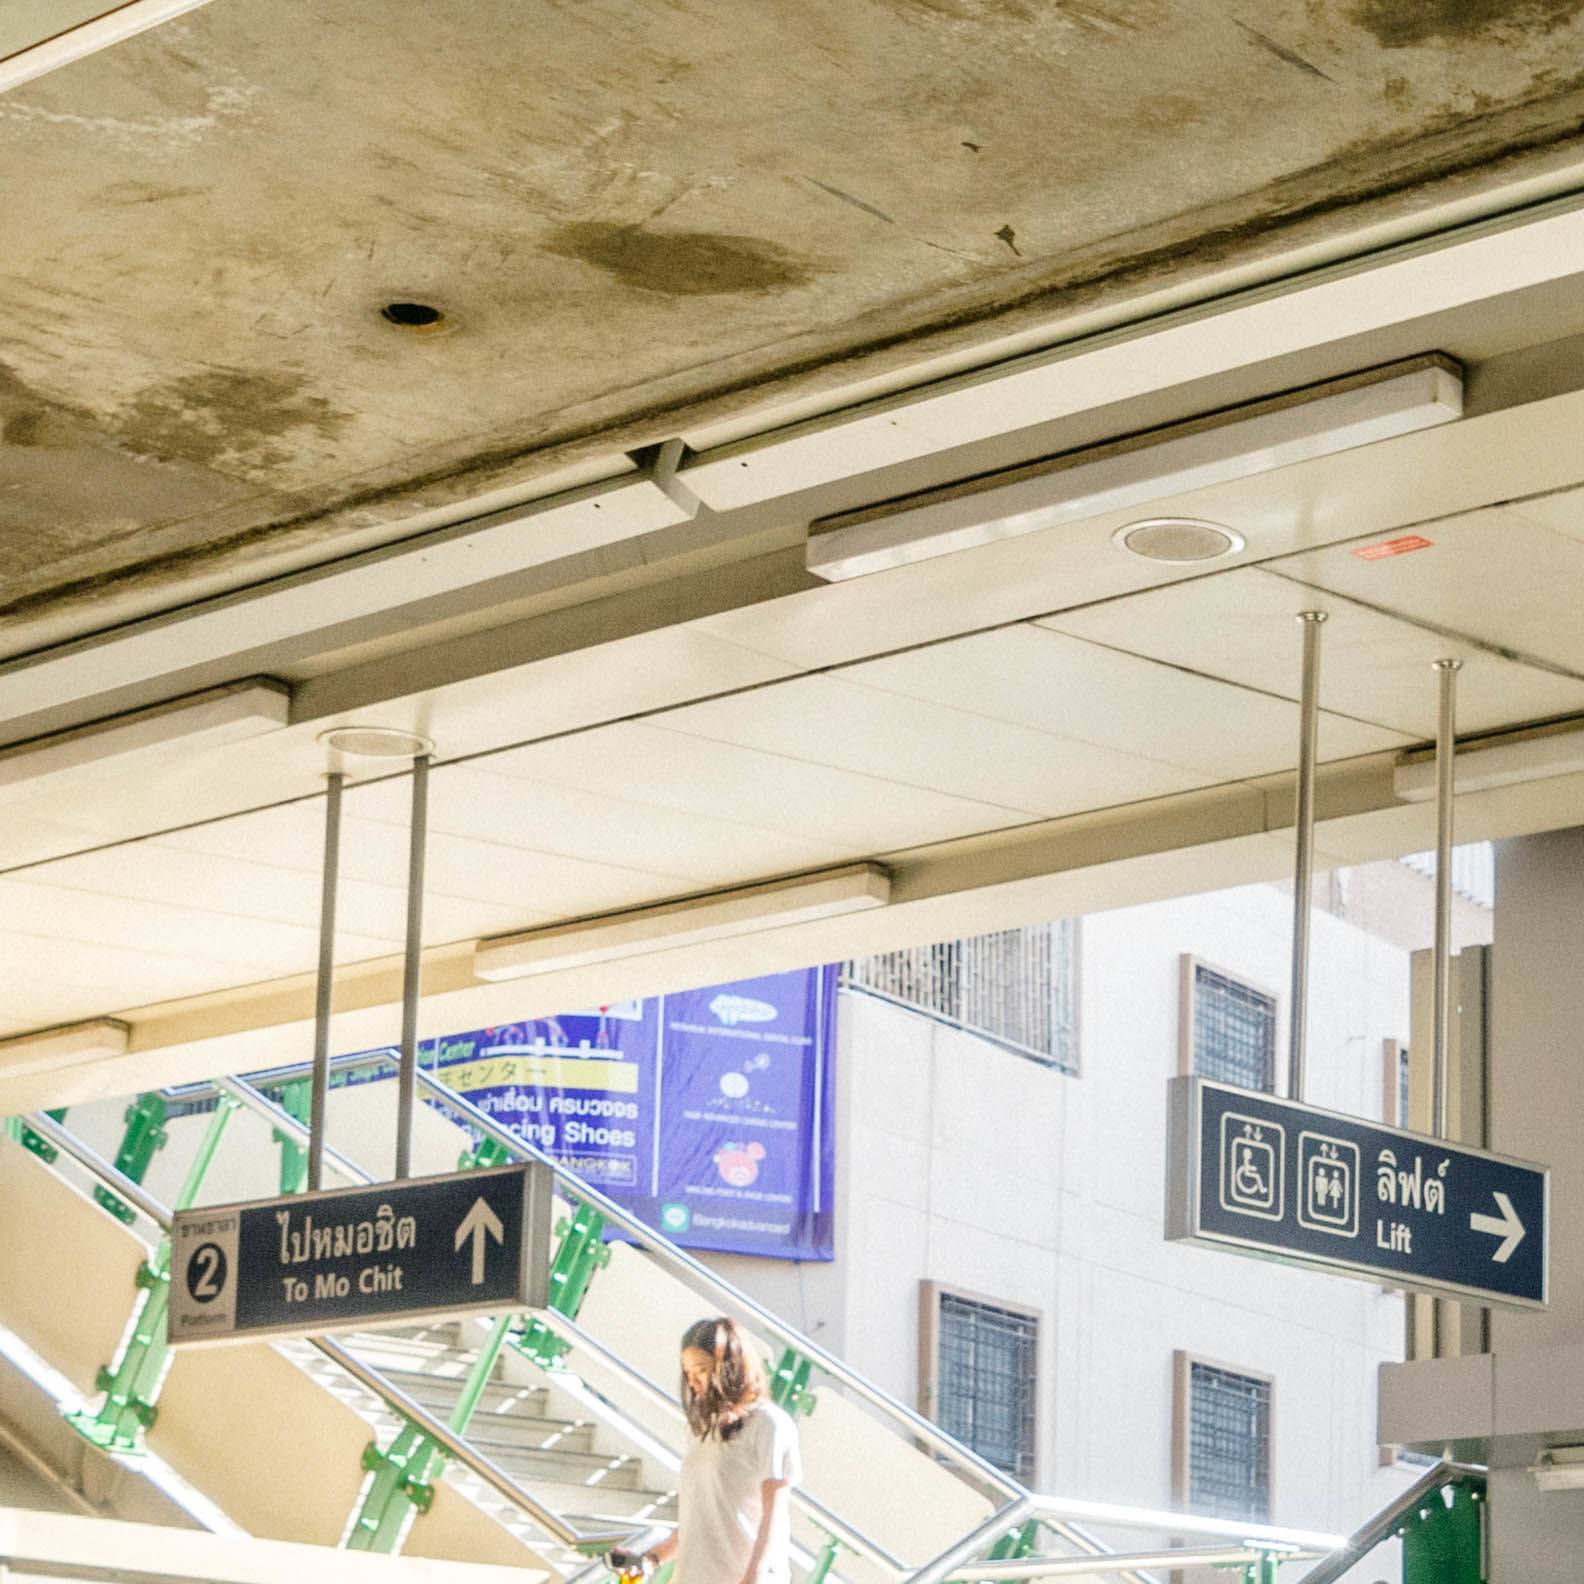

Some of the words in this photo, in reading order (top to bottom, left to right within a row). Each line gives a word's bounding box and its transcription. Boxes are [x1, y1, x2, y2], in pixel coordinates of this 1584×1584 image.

[564, 1121, 637, 1147] Shoes
[1377, 1149, 1450, 1215] ลิฟต์
[276, 1204, 416, 1264] ไปหมอชิต
[1377, 1219, 1412, 1254] Lift
[195, 1247, 219, 1297] 2
[282, 1276, 308, 1303] To
[315, 1272, 349, 1298] Mo
[359, 1264, 404, 1294] Chit
